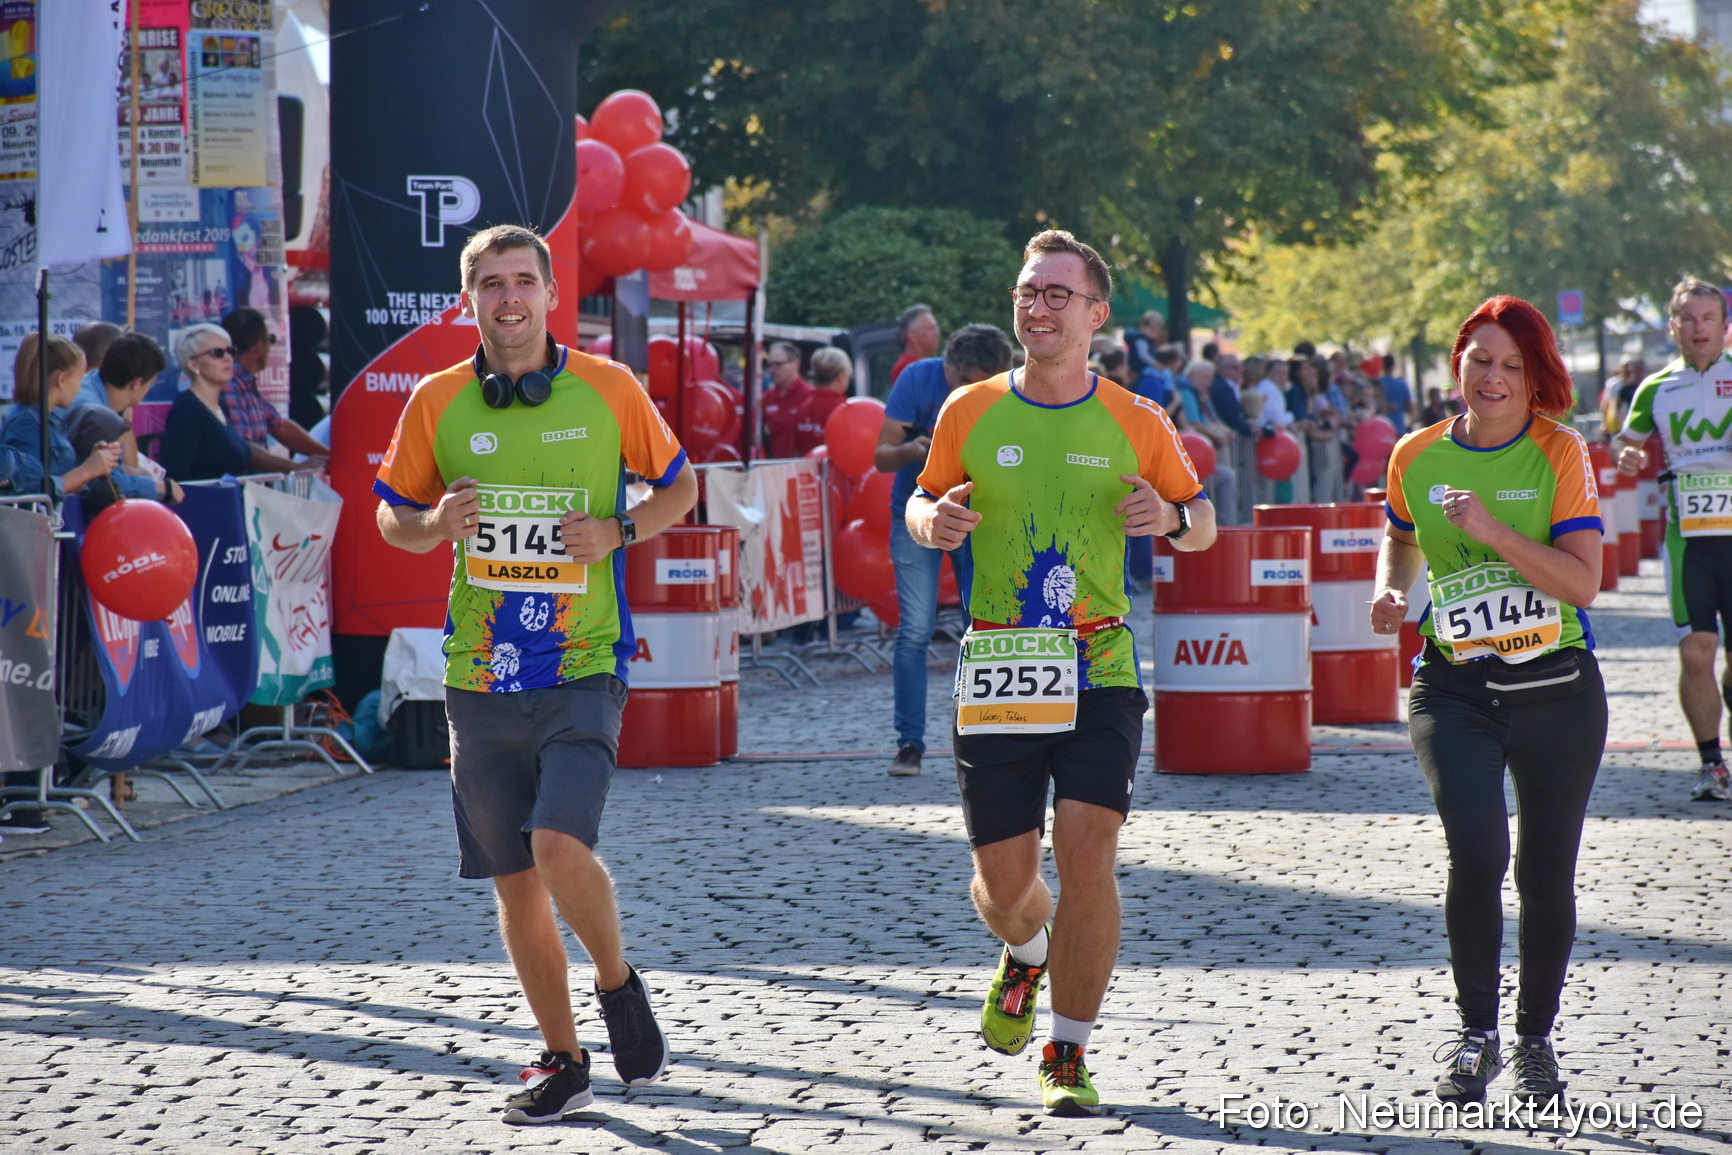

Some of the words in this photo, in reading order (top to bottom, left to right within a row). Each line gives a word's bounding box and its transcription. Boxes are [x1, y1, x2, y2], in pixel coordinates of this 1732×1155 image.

[143, 106, 181, 122] JAHRE
[412, 181, 434, 190] Team
[203, 228, 231, 242] 2019
[386, 292, 417, 309] THE
[365, 308, 389, 325] 100
[390, 309, 443, 326] YEARS
[365, 372, 419, 393] BMW
[542, 427, 587, 442] BOCK
[1067, 453, 1110, 468] BOCK
[477, 490, 577, 515] BOCK
[1496, 490, 1538, 501] BOCK
[487, 563, 559, 580] LASZLO
[1448, 590, 1546, 640] 5144
[206, 624, 247, 644] MOBILE
[970, 633, 1068, 658] BOCK
[972, 665, 1062, 699] 5252
[1005, 710, 1027, 723] Tobias
